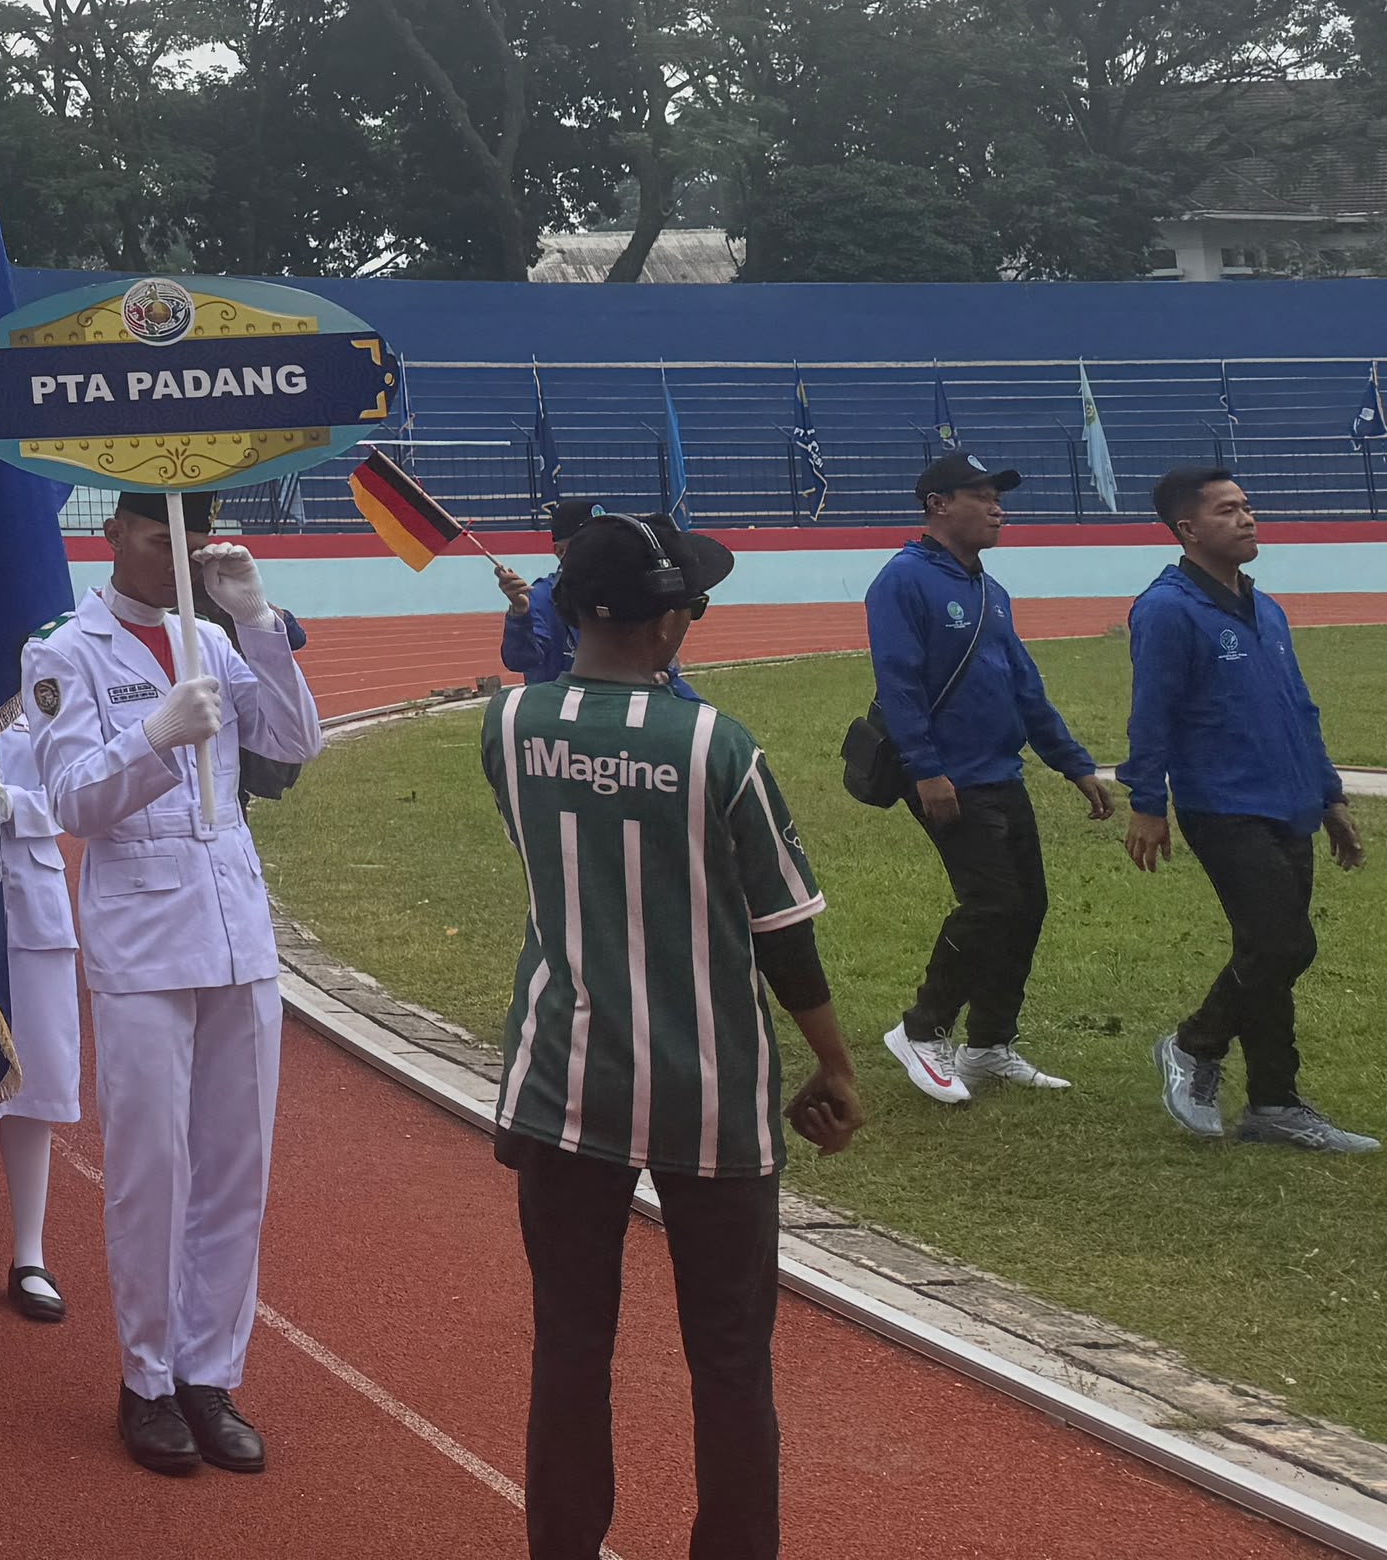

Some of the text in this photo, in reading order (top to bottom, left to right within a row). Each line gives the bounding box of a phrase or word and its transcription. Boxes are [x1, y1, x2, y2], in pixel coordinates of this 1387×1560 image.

[31, 364, 308, 405] PTA PADANG
[524, 737, 678, 795] iMagine
